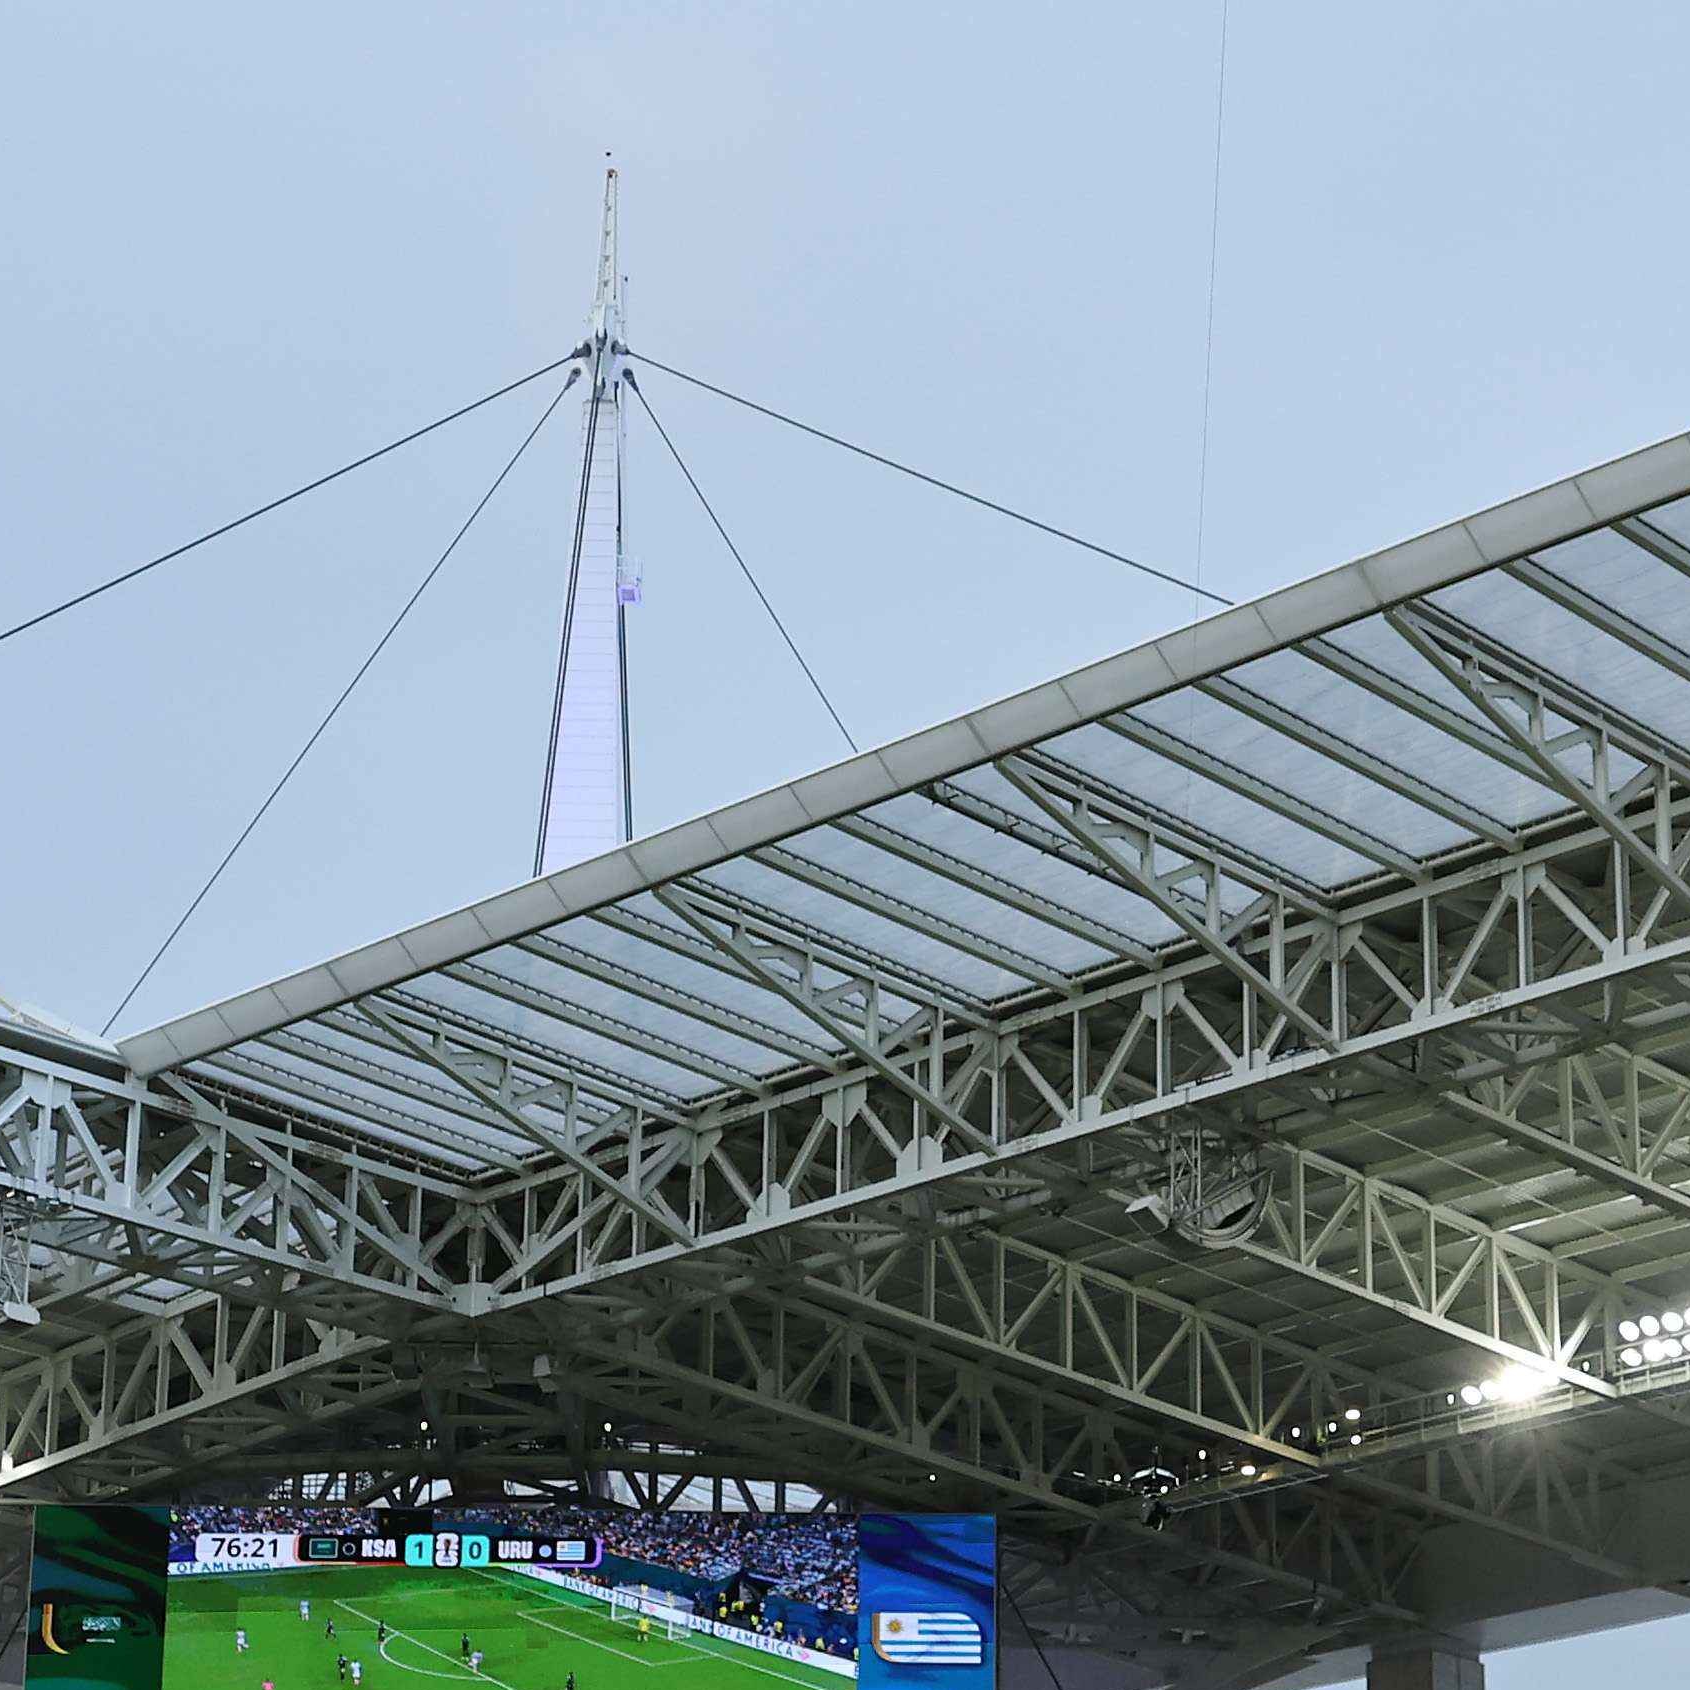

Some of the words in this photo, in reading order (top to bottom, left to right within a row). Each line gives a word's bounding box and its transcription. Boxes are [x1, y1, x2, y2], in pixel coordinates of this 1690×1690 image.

[211, 1537, 279, 1559] 76:21
[362, 1538, 397, 1558] KSA
[414, 1541, 424, 1559] 1
[468, 1541, 482, 1559] 0
[498, 1540, 534, 1559] URU
